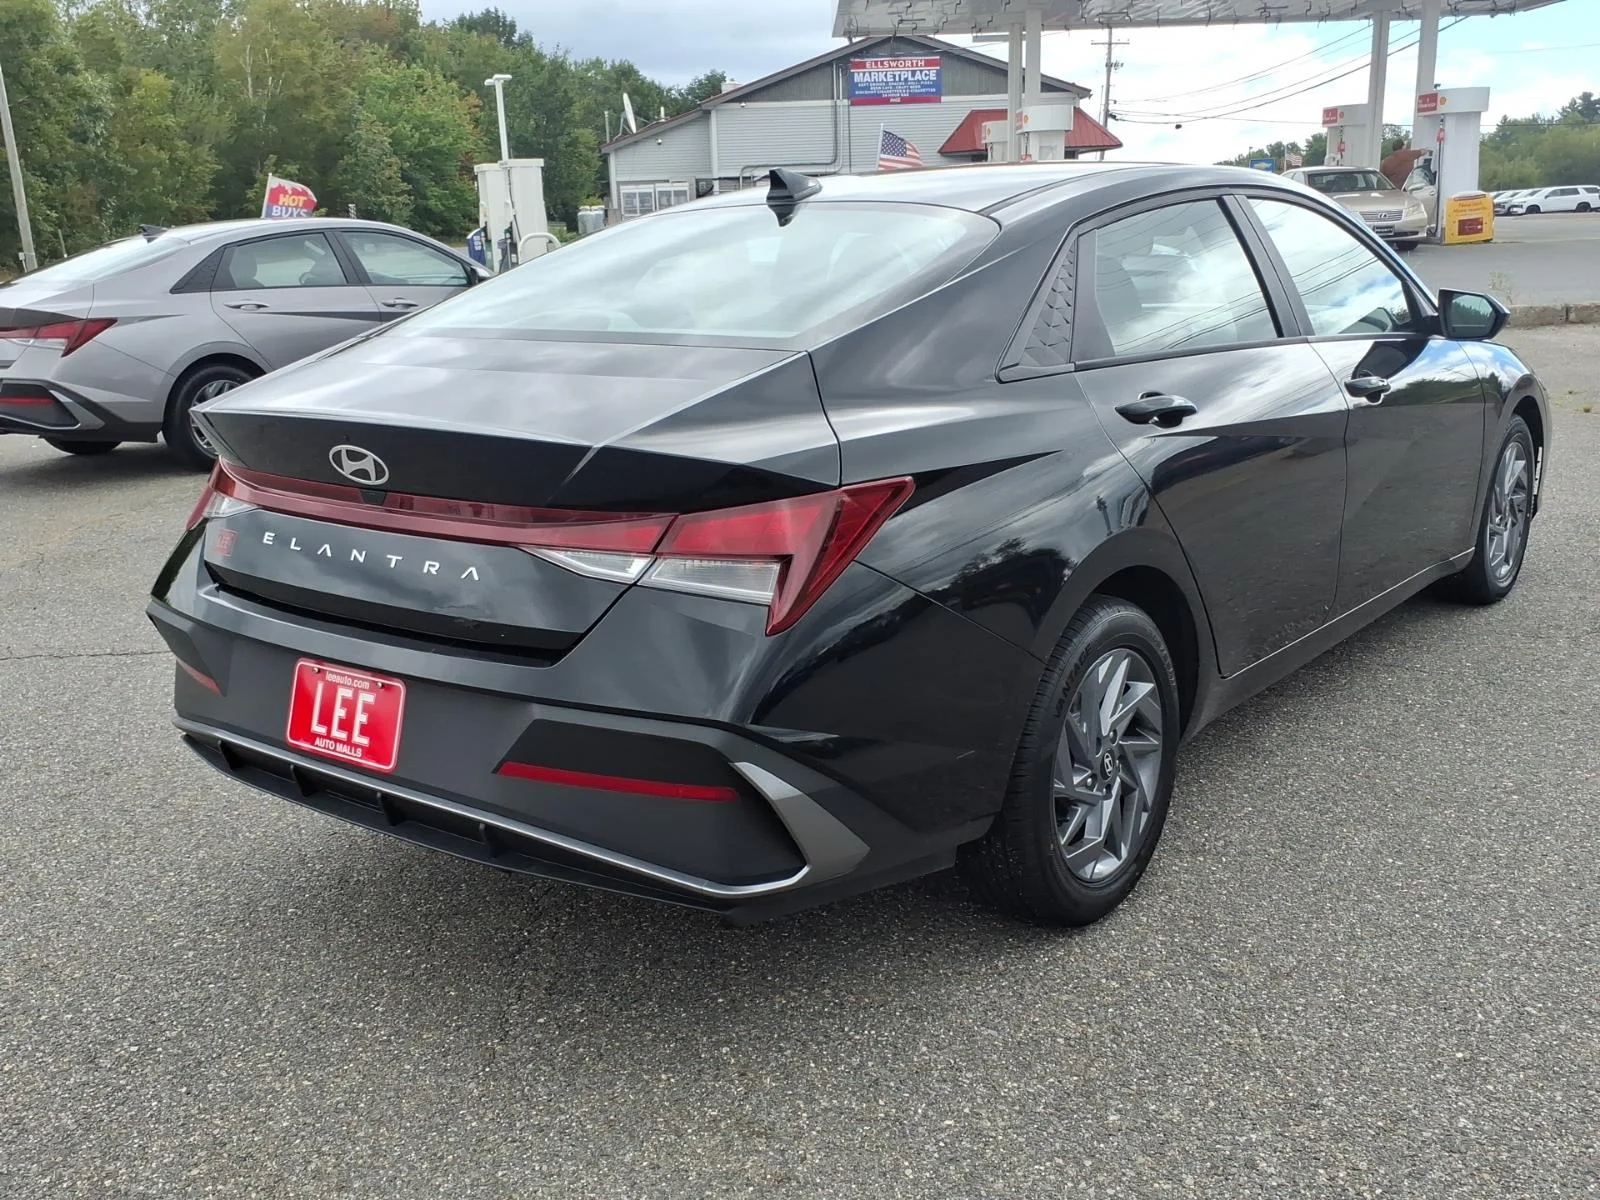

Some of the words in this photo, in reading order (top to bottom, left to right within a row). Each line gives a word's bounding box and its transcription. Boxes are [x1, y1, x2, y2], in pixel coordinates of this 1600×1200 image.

[866, 60, 925, 69] ELLSWORTH
[854, 70, 937, 83] MARKETPLACE
[279, 193, 307, 207] HOT
[272, 205, 308, 218] BUYS
[262, 531, 480, 581] ELANTRA
[325, 671, 370, 689] leeauto.com
[311, 681, 377, 747] LEE
[314, 737, 336, 750] AUTO
[336, 742, 362, 758] MALLS
